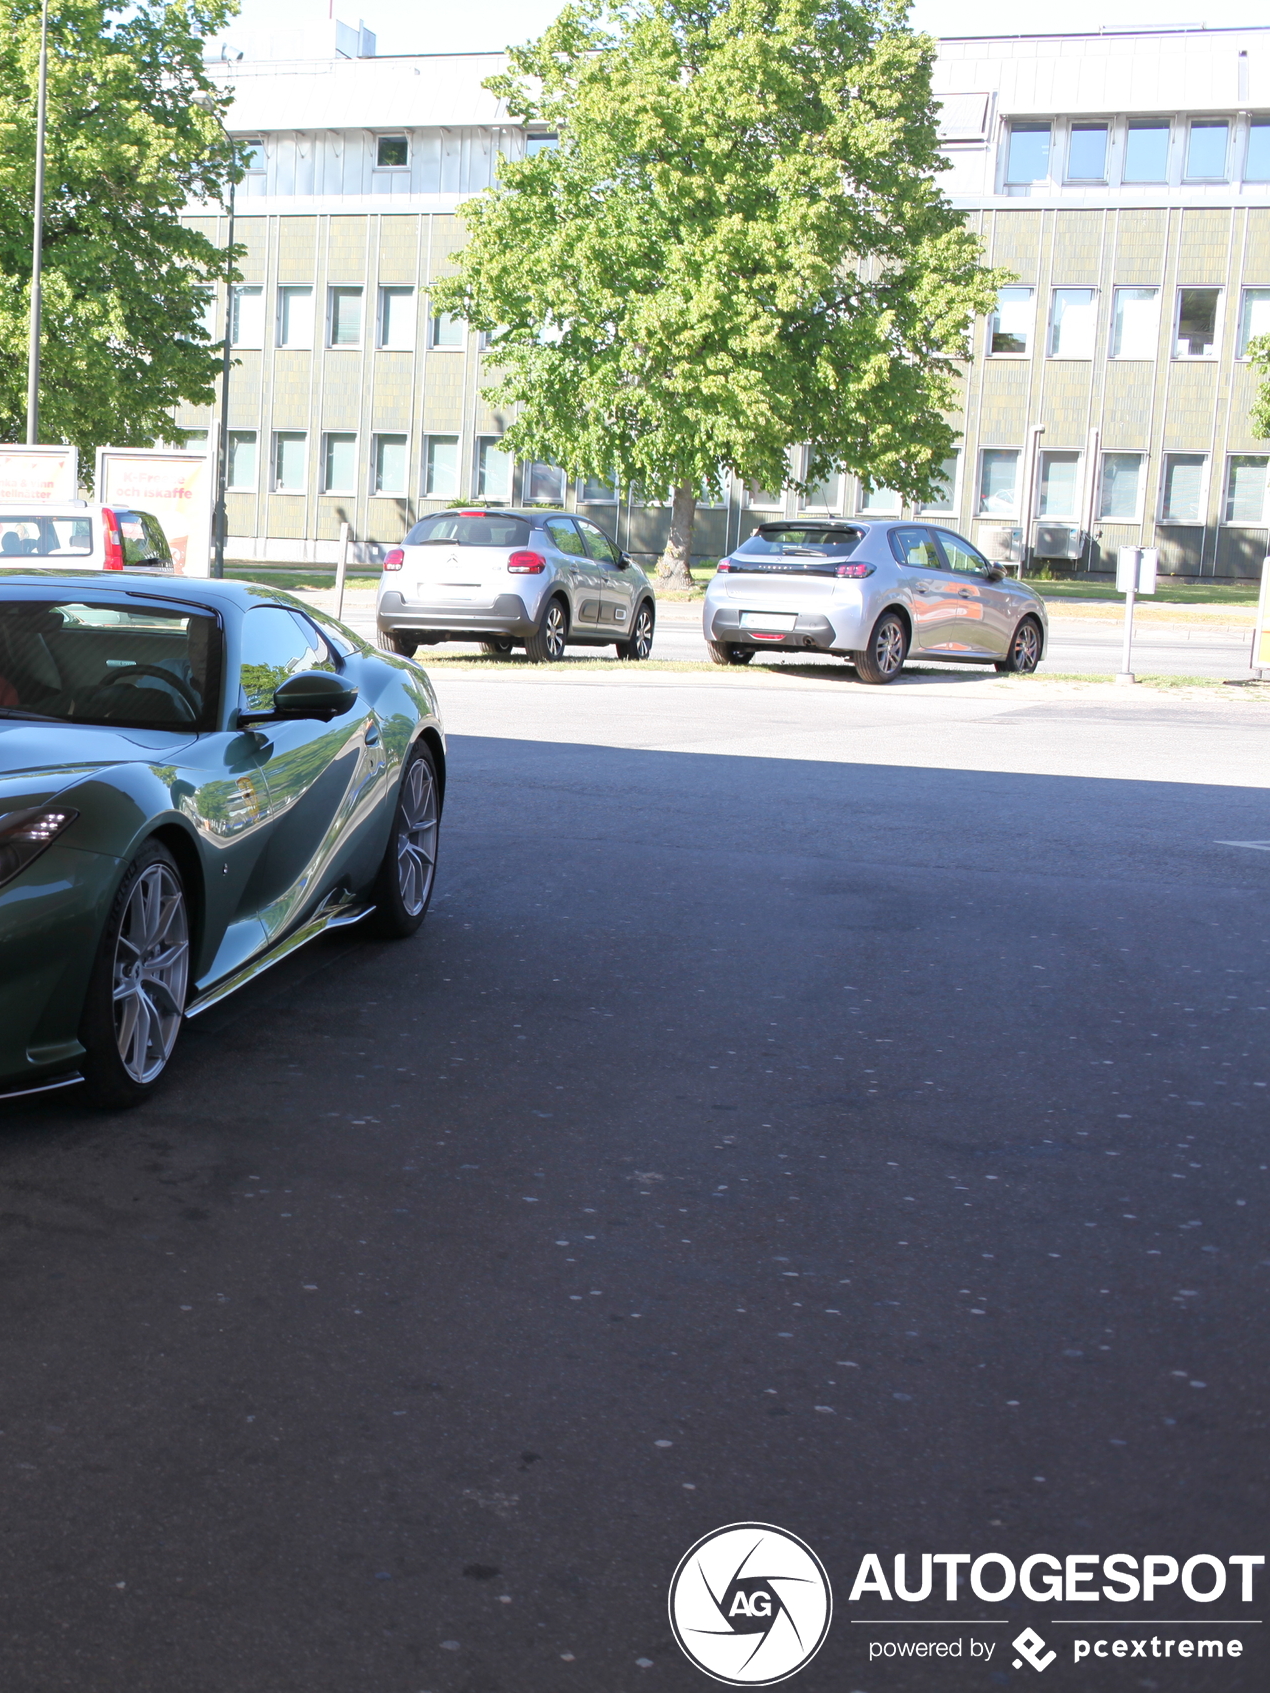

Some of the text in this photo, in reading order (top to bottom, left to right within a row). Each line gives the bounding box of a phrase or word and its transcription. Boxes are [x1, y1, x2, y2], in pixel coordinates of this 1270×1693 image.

[123, 472, 186, 484] K-Freee
[116, 487, 193, 499] och iskaffe
